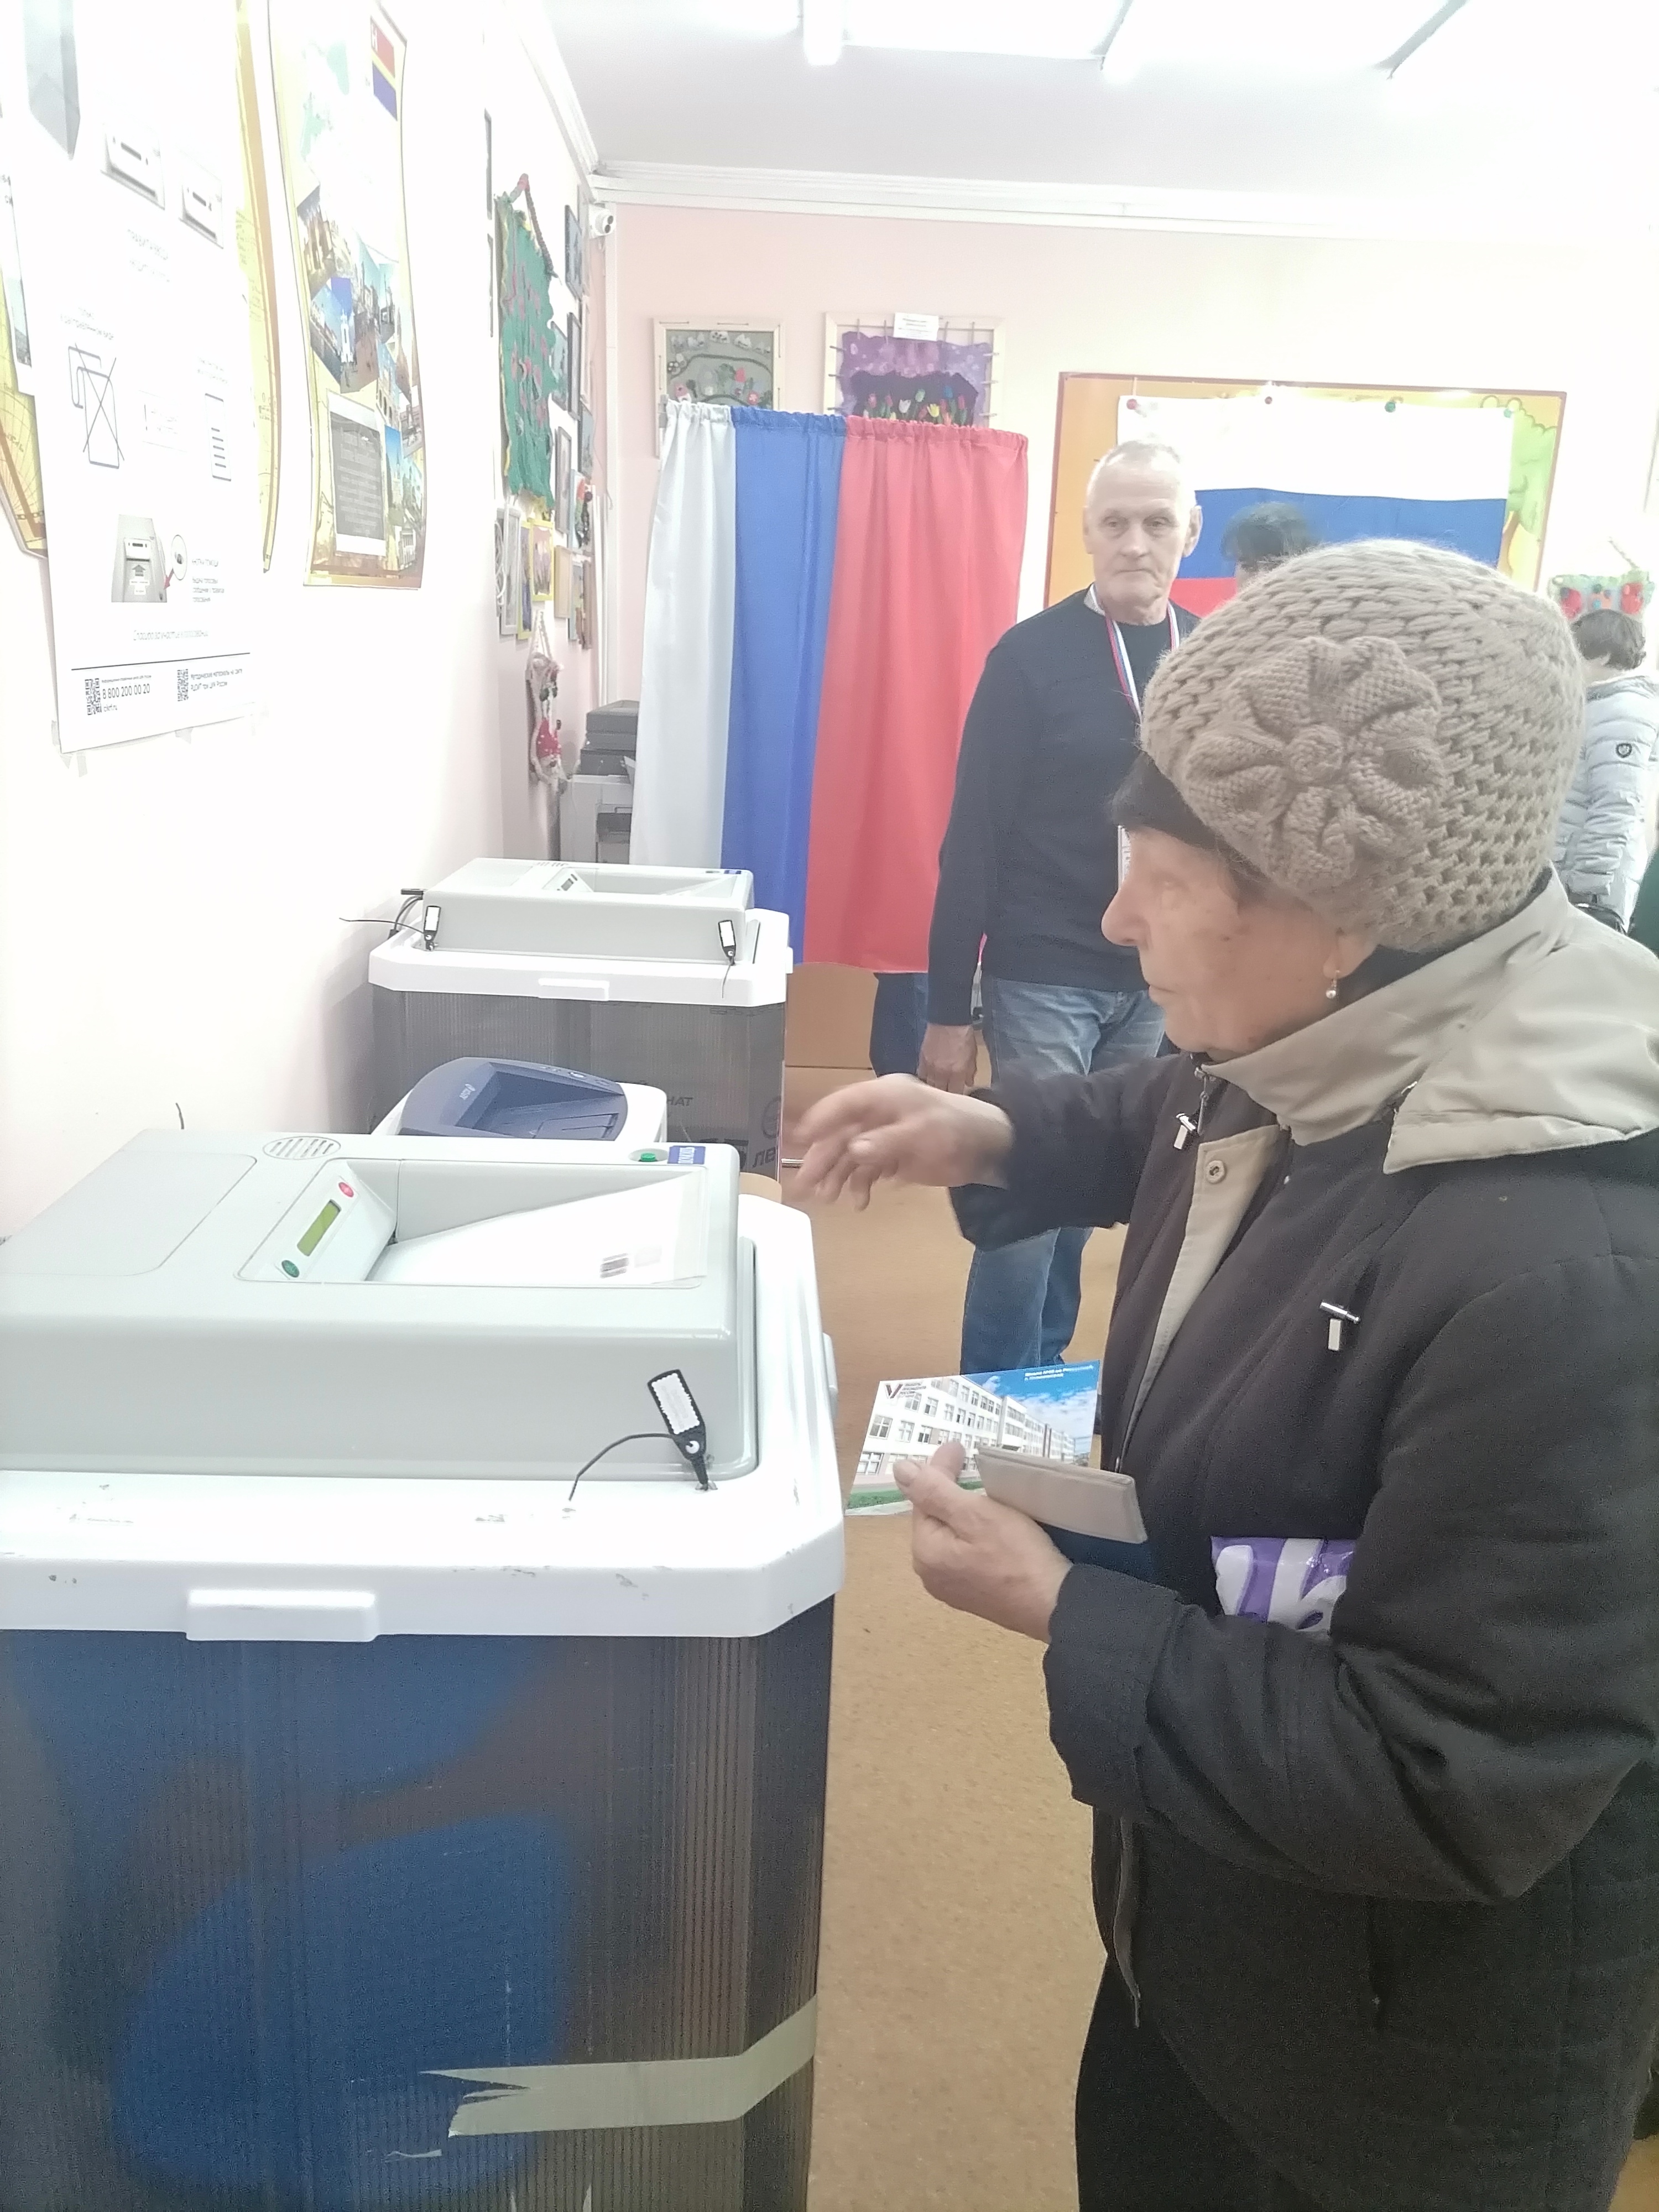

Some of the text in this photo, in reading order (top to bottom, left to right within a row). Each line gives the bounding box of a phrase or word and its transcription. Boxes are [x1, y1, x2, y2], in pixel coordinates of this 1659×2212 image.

[102, 683, 150, 700] 8 800 200 00 20
